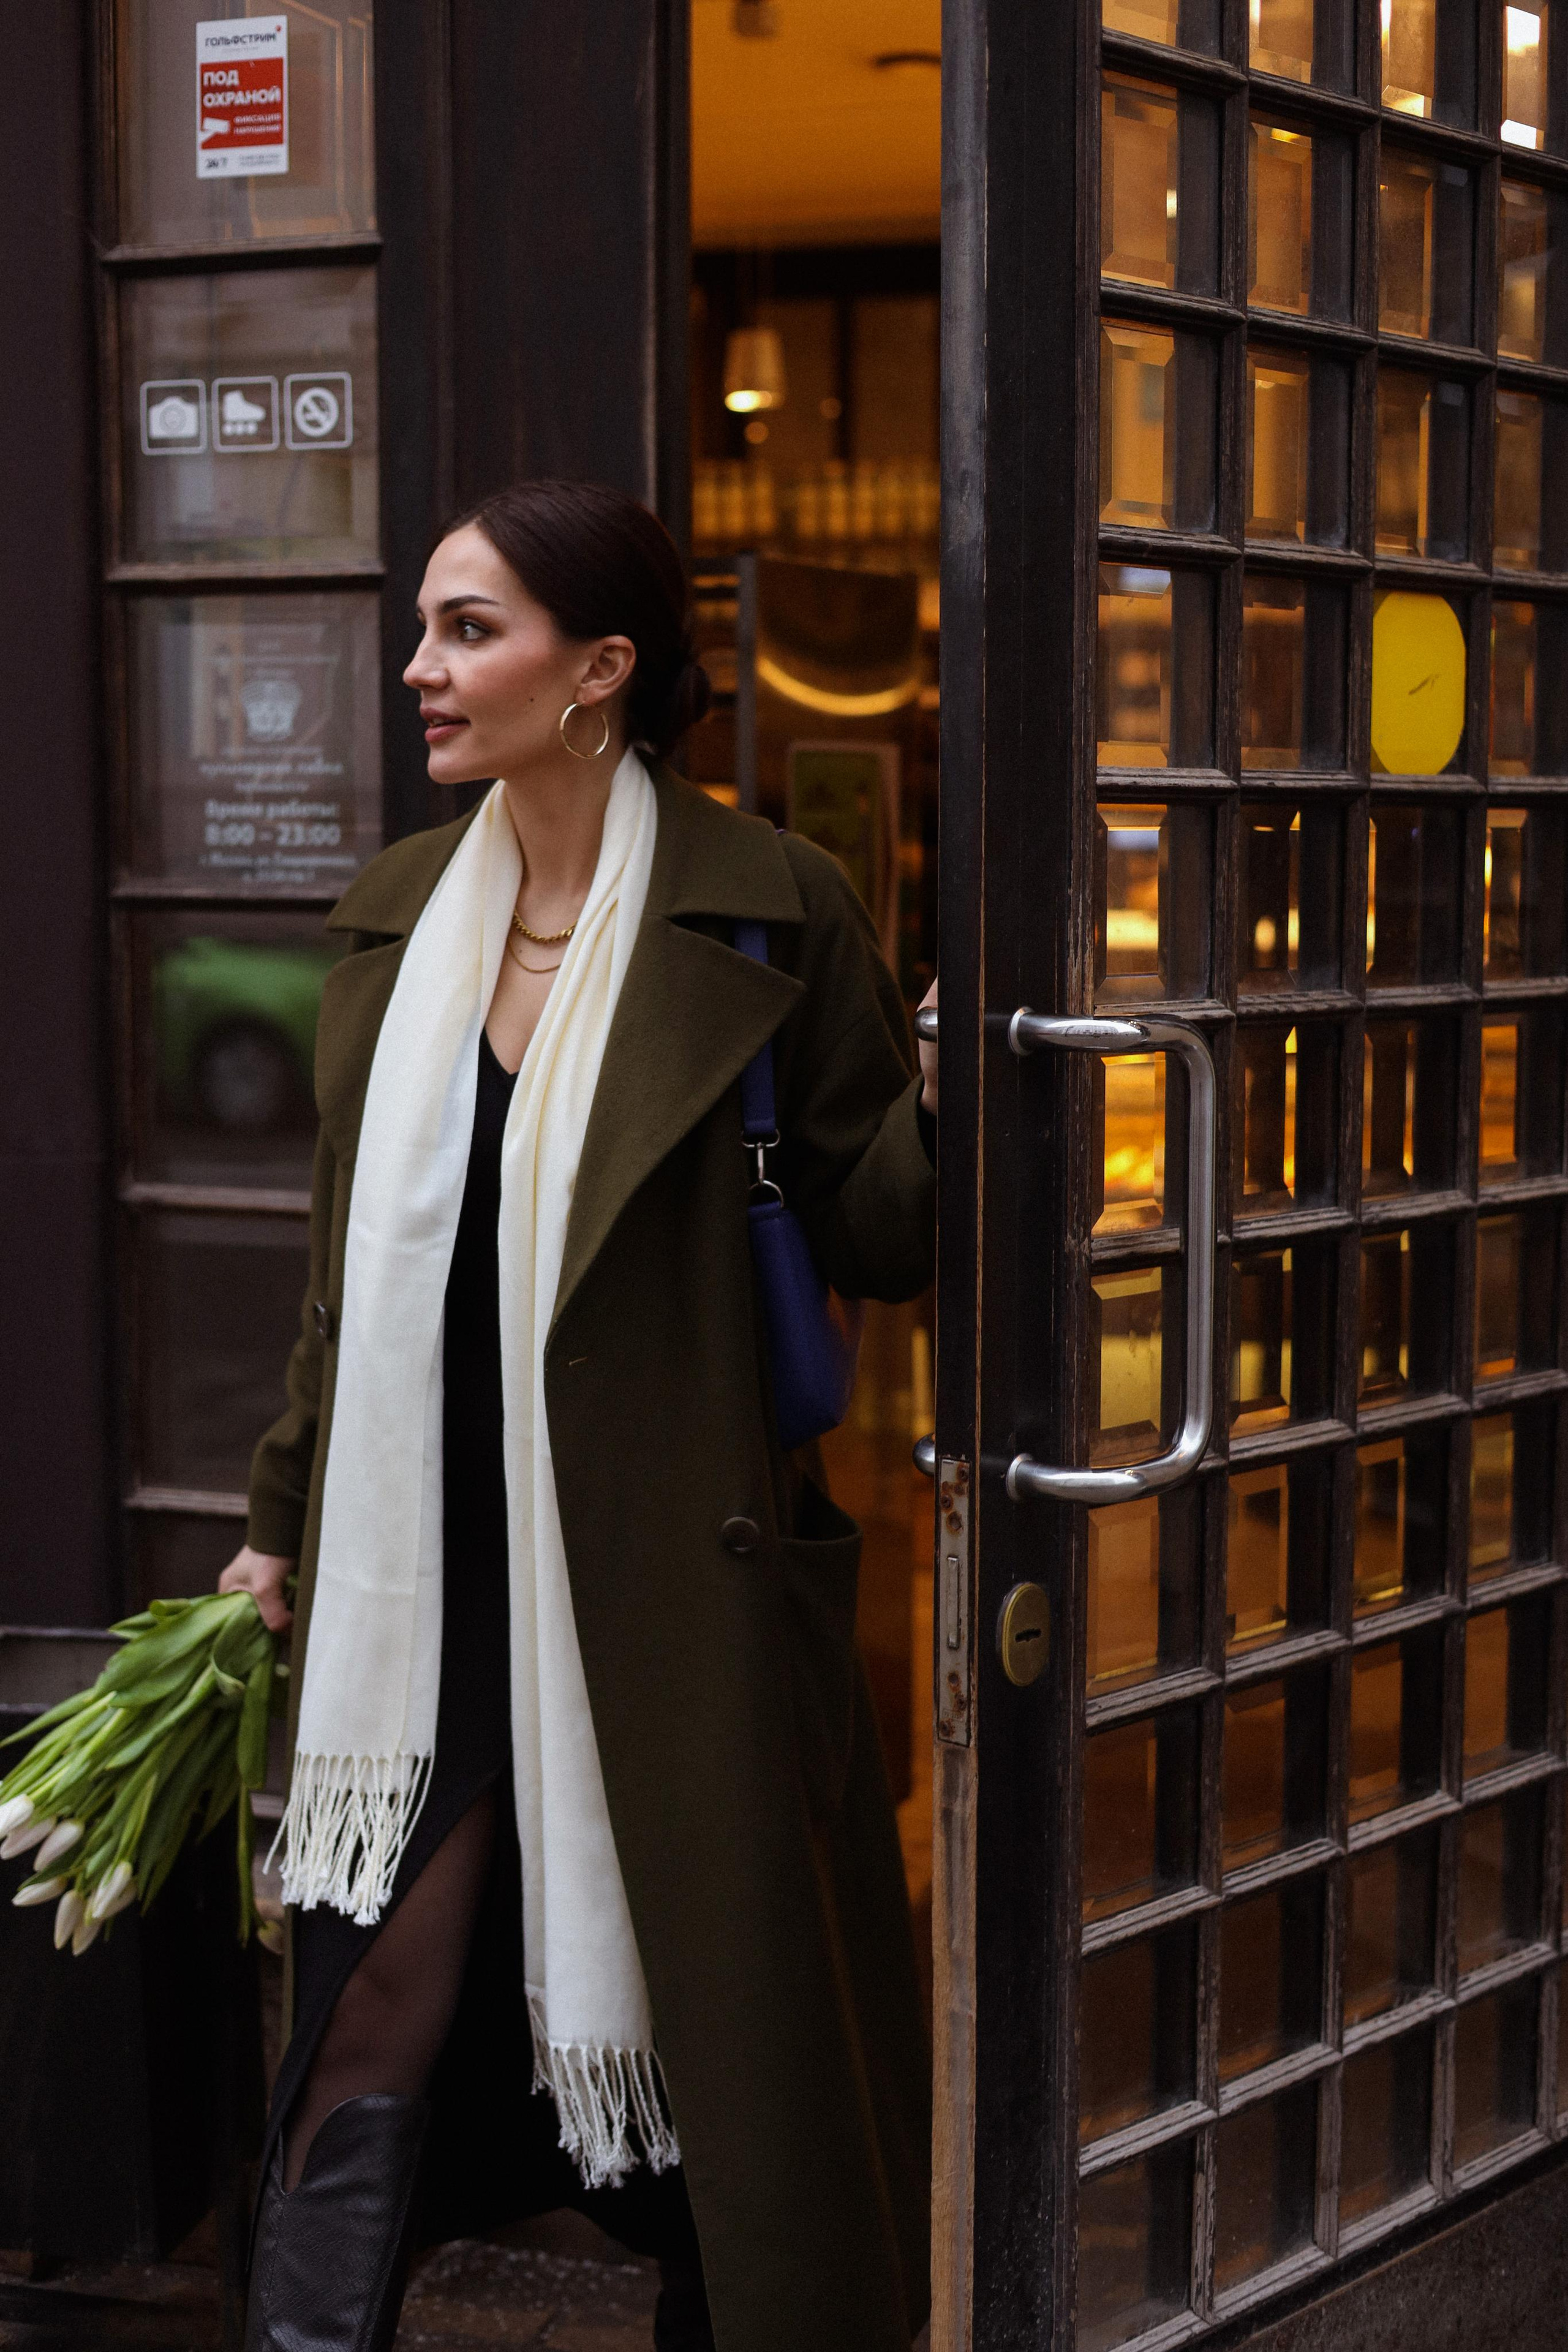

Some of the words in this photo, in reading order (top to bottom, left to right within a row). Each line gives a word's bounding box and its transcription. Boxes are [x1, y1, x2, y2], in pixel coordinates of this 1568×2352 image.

[205, 33, 276, 47] ГОЛЬФСТРИМ
[203, 70, 239, 86] ПОД
[203, 86, 281, 107] ОХРАНОЙ
